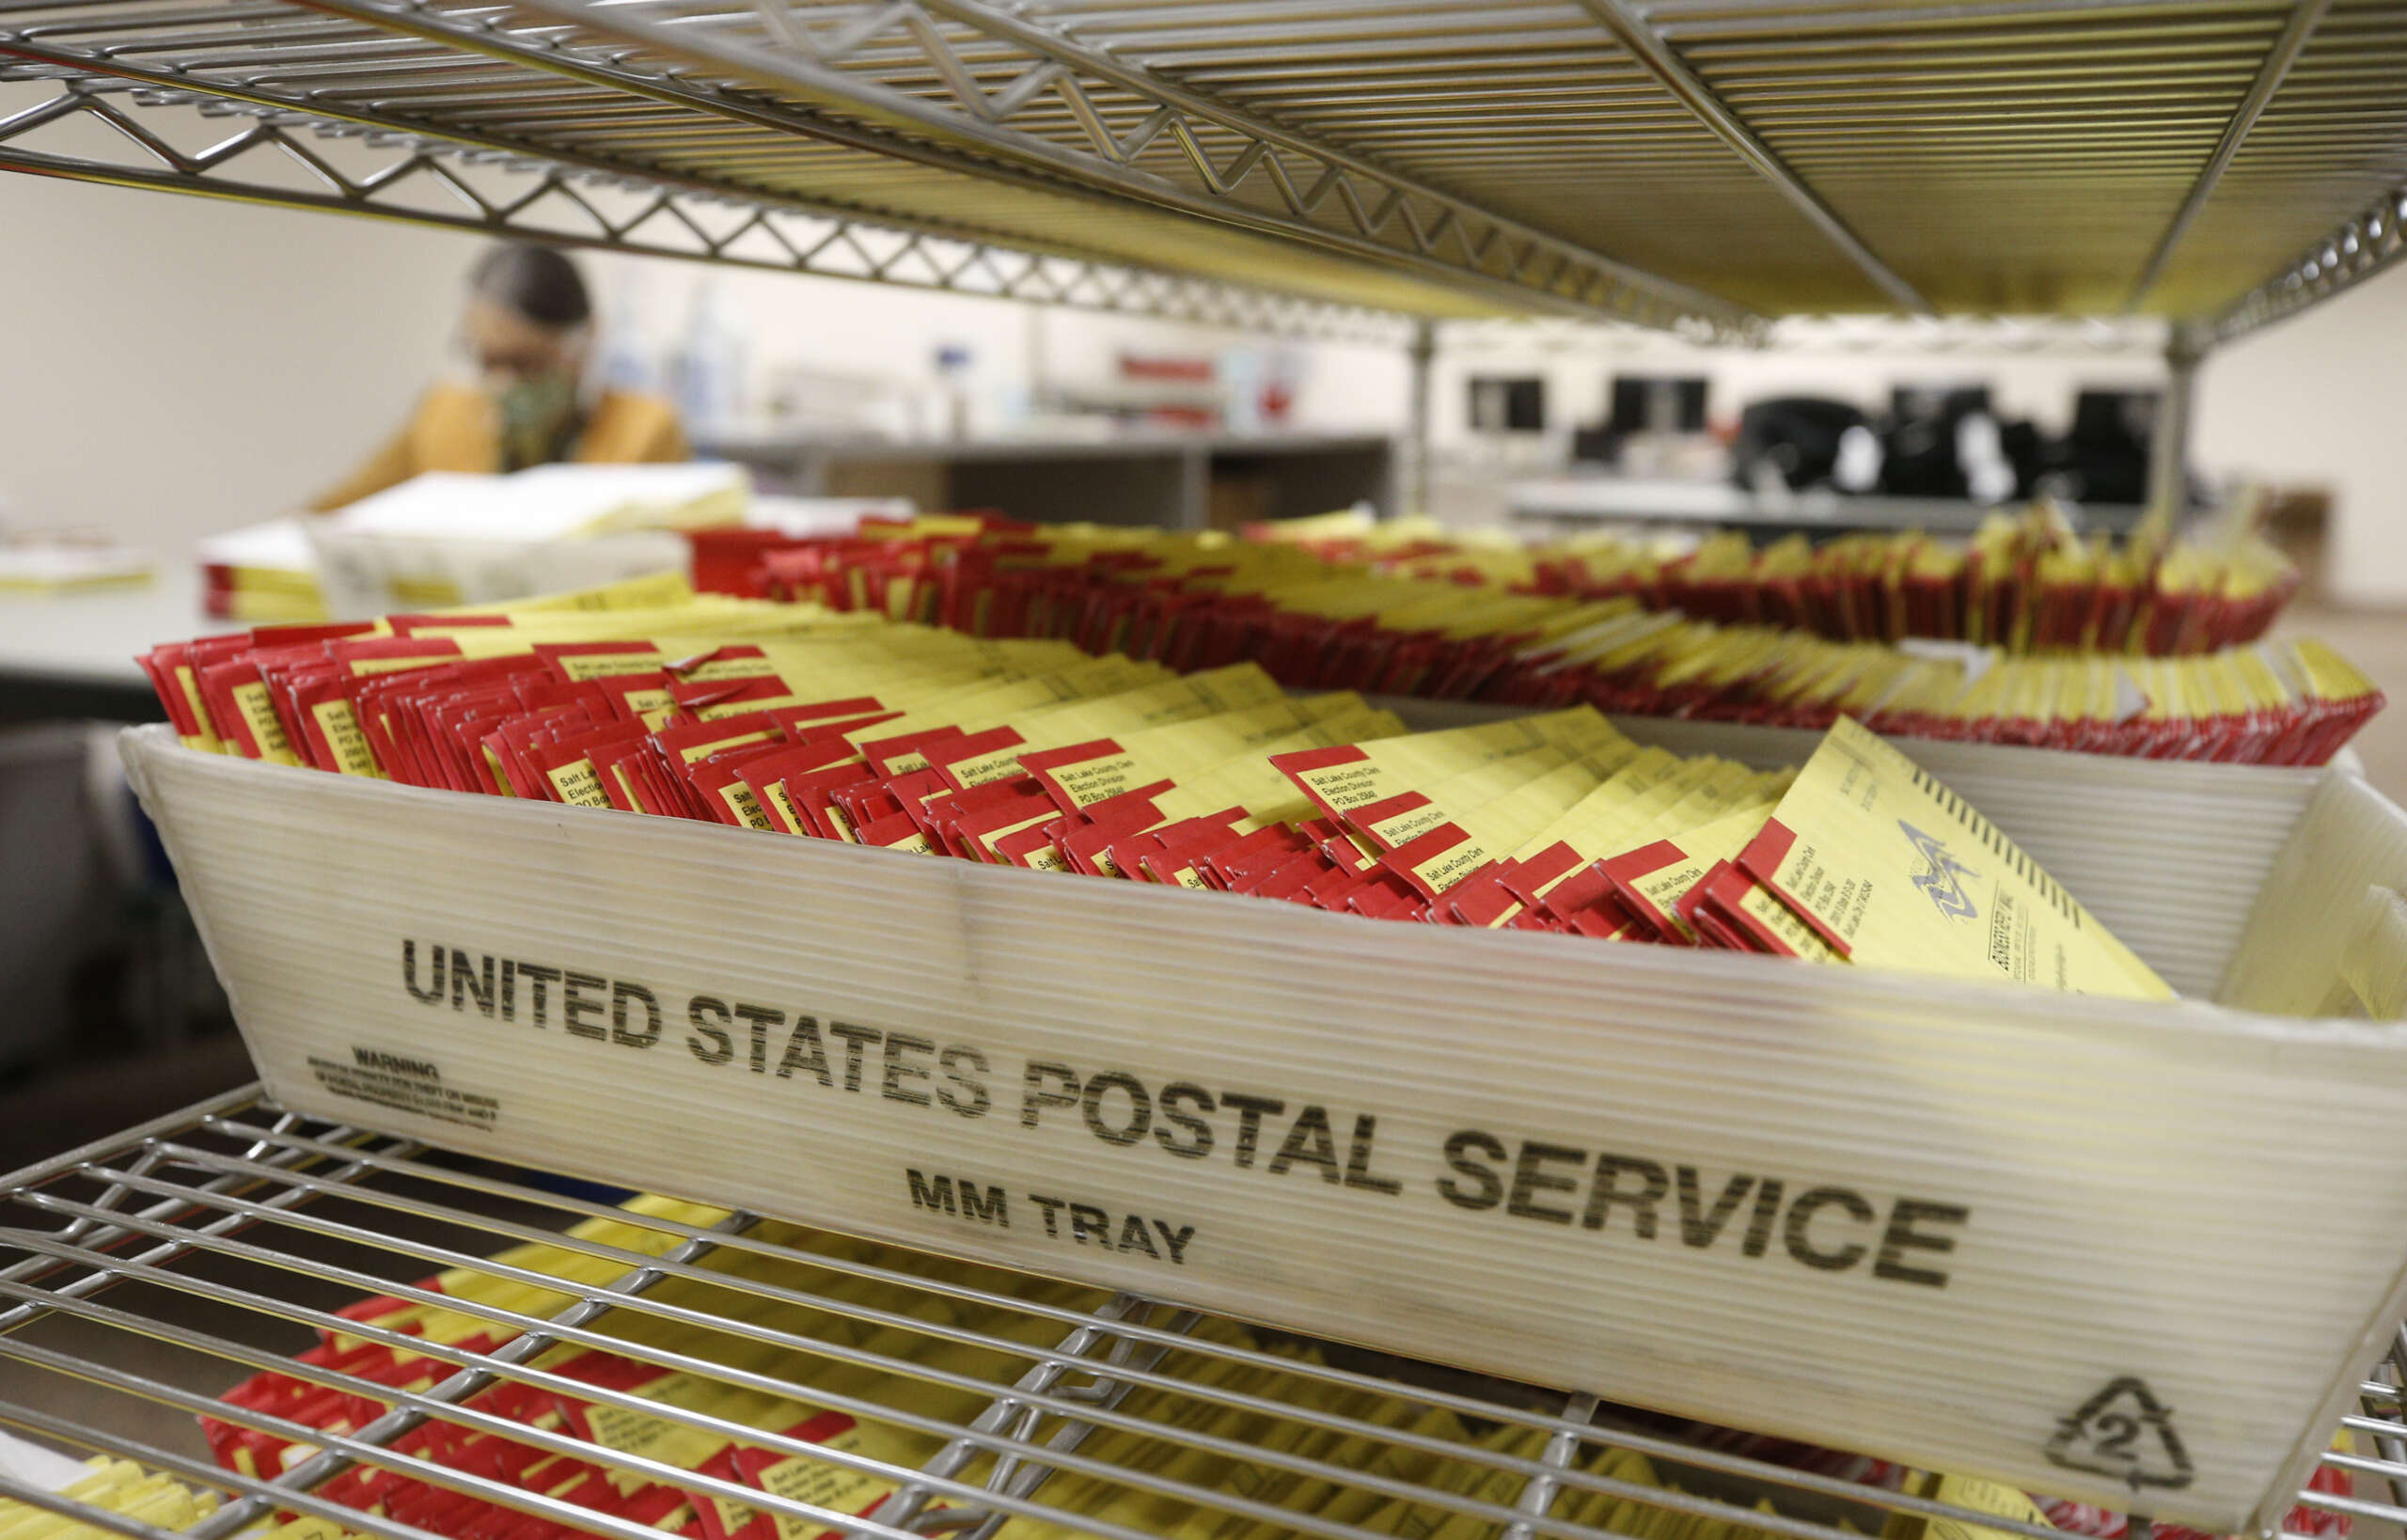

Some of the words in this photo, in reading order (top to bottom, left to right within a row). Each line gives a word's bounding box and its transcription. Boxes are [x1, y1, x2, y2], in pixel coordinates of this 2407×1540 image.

[559, 773, 580, 787] Salt
[1311, 776, 1327, 785] Salt
[1325, 774, 1343, 782] Lake
[1341, 769, 1365, 780] County
[567, 781, 603, 799] Electio
[1322, 784, 1350, 795] Election
[1347, 778, 1375, 789] Division
[1078, 794, 1092, 803] PO
[1344, 794, 1359, 803] Box
[1425, 869, 1441, 880] Salt
[1438, 862, 1454, 874] Lake
[1450, 853, 1472, 869] County
[1467, 845, 1484, 857] Clerk
[352, 1045, 440, 1078] WARNING
[402, 938, 662, 1049] UNITED
[685, 994, 992, 1120] STATES
[1019, 1060, 1402, 1197] POSTAL
[1436, 1129, 1968, 1288] SERVICE
[906, 1168, 1010, 1227] MM
[1028, 1193, 1195, 1265] TRAY
[2094, 1412, 2140, 1461] 2
